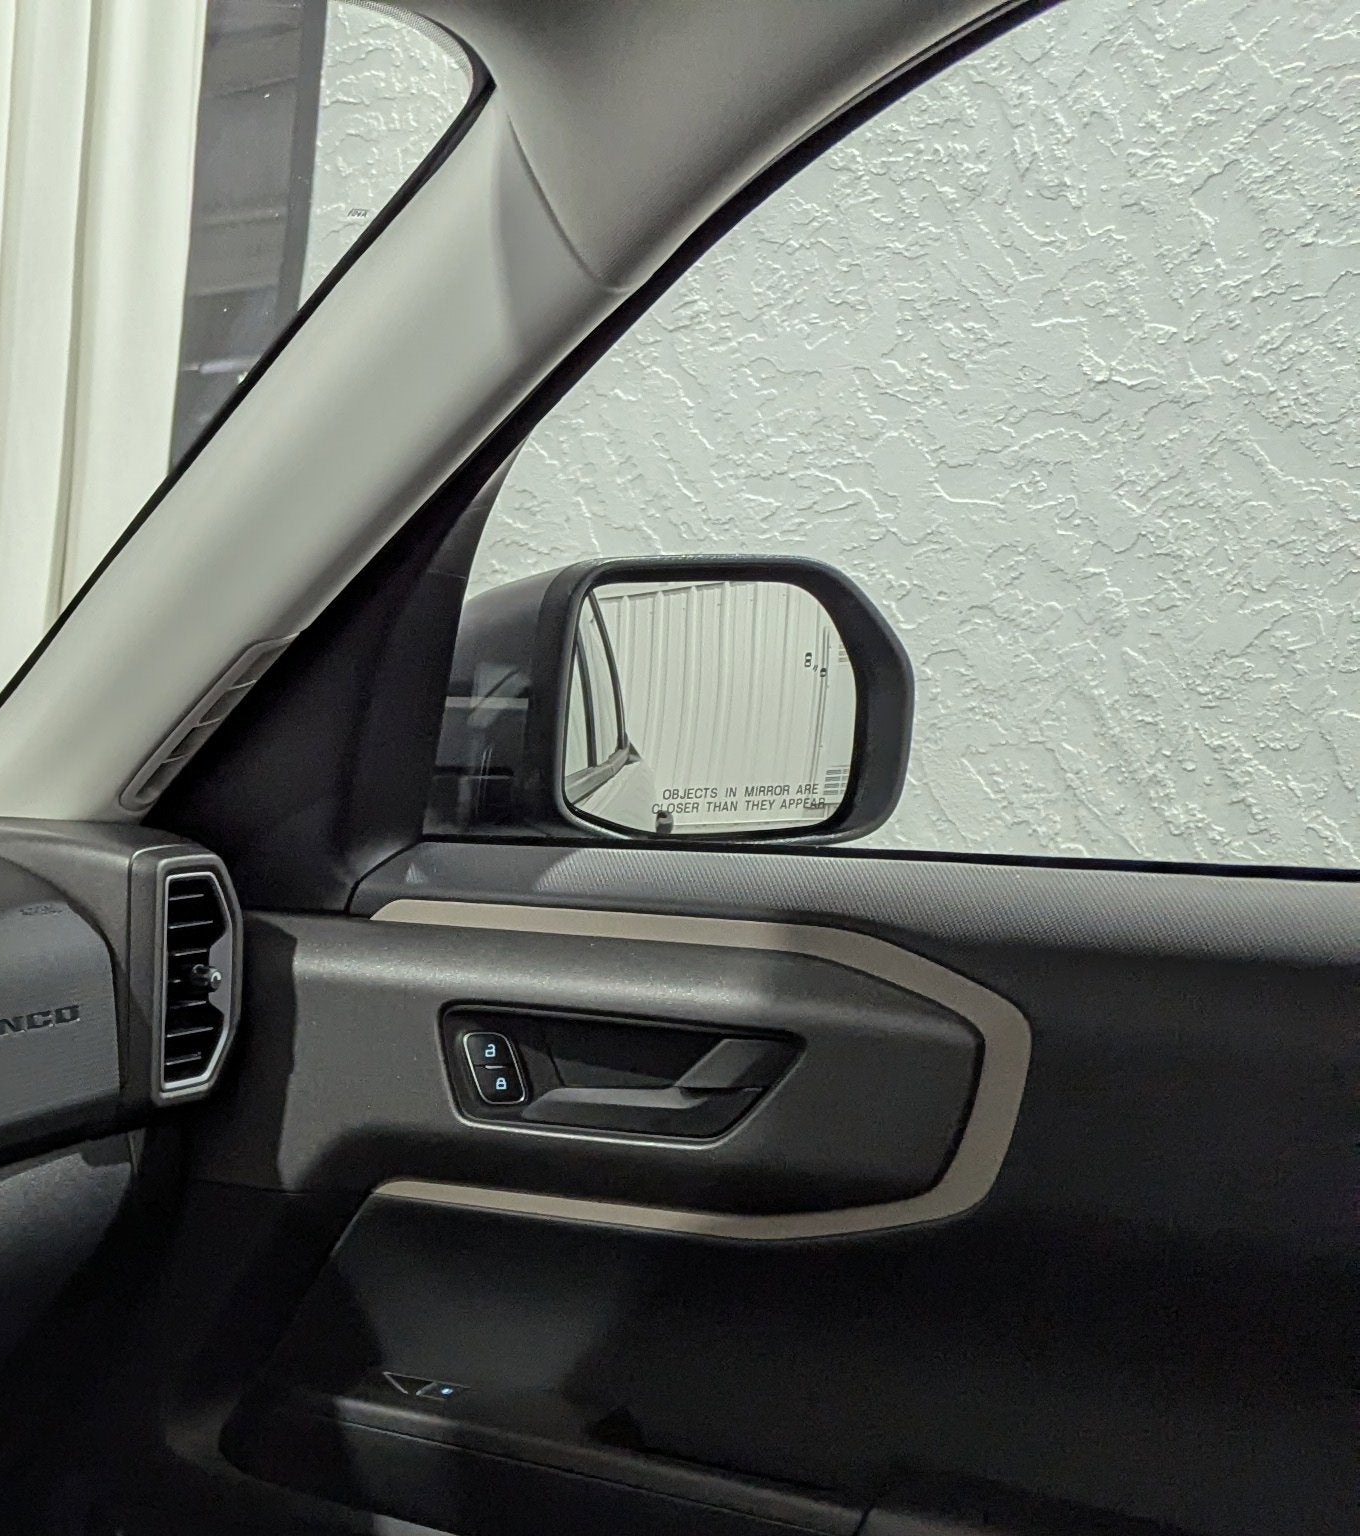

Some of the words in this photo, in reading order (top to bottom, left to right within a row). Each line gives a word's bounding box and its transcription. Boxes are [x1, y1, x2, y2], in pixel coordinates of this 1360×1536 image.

[662, 787, 718, 800] OBJECTS
[725, 786, 737, 798] IN
[744, 784, 791, 797] MIRROR
[795, 783, 819, 795] ARE
[707, 800, 739, 813] THAN
[746, 799, 776, 811] THEY
[780, 797, 826, 810] APPEAR
